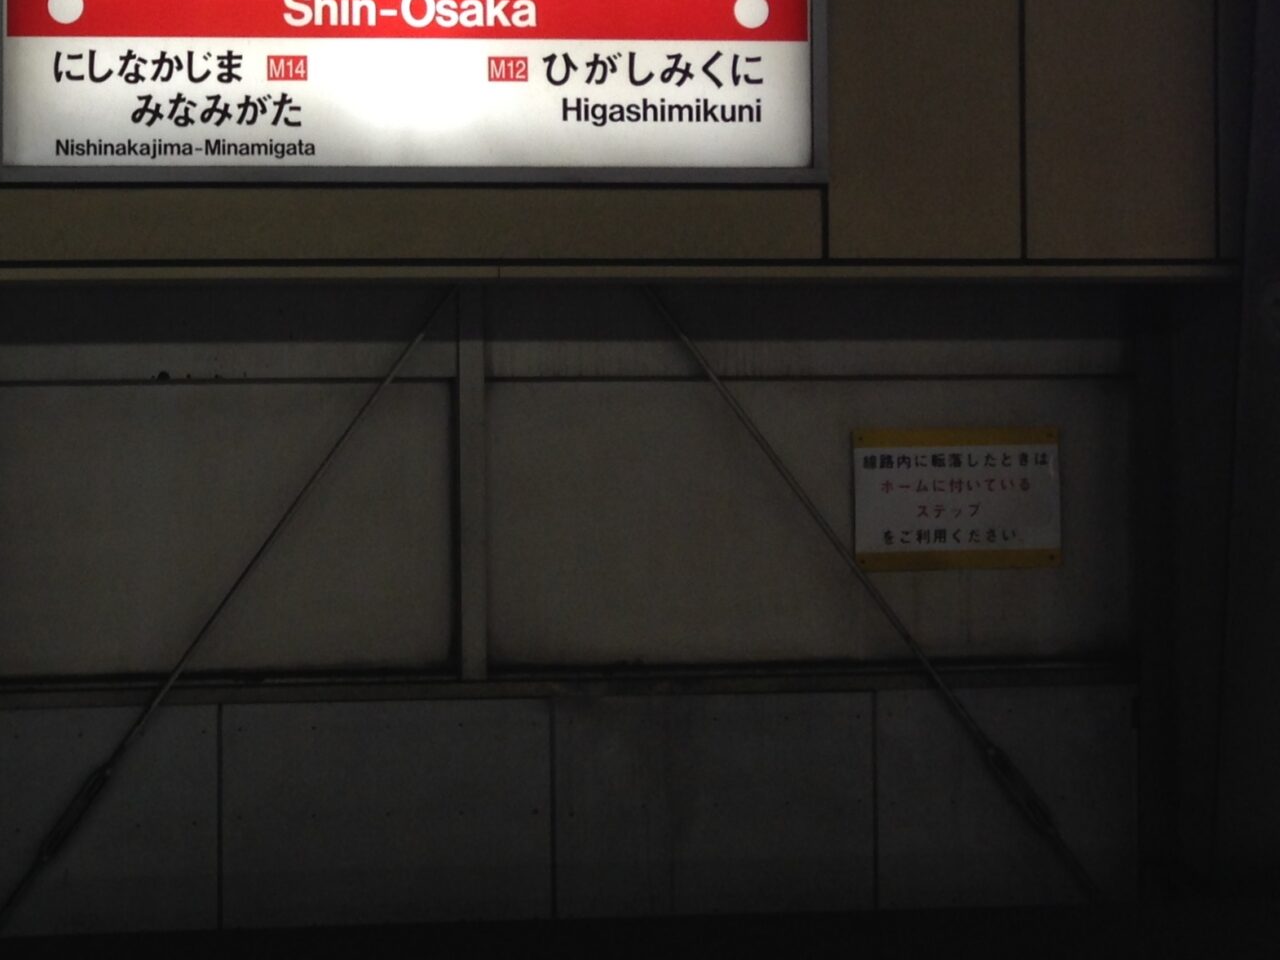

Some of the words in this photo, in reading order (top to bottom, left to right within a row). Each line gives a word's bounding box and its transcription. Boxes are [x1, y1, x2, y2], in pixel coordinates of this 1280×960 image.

[53, 49, 243, 84] にしなかじま
[268, 58, 307, 79] M14
[489, 59, 527, 80] M12
[542, 50, 764, 89] ひがしみくに
[130, 91, 302, 128] みなみがた
[561, 97, 762, 128] Higashimikuni
[55, 138, 316, 159] Nishinakajima-Minamigata
[862, 451, 1049, 470] 線路内に転落したときは
[880, 478, 1031, 494] ホームに付いている
[883, 528, 1016, 545] をご利用ください
